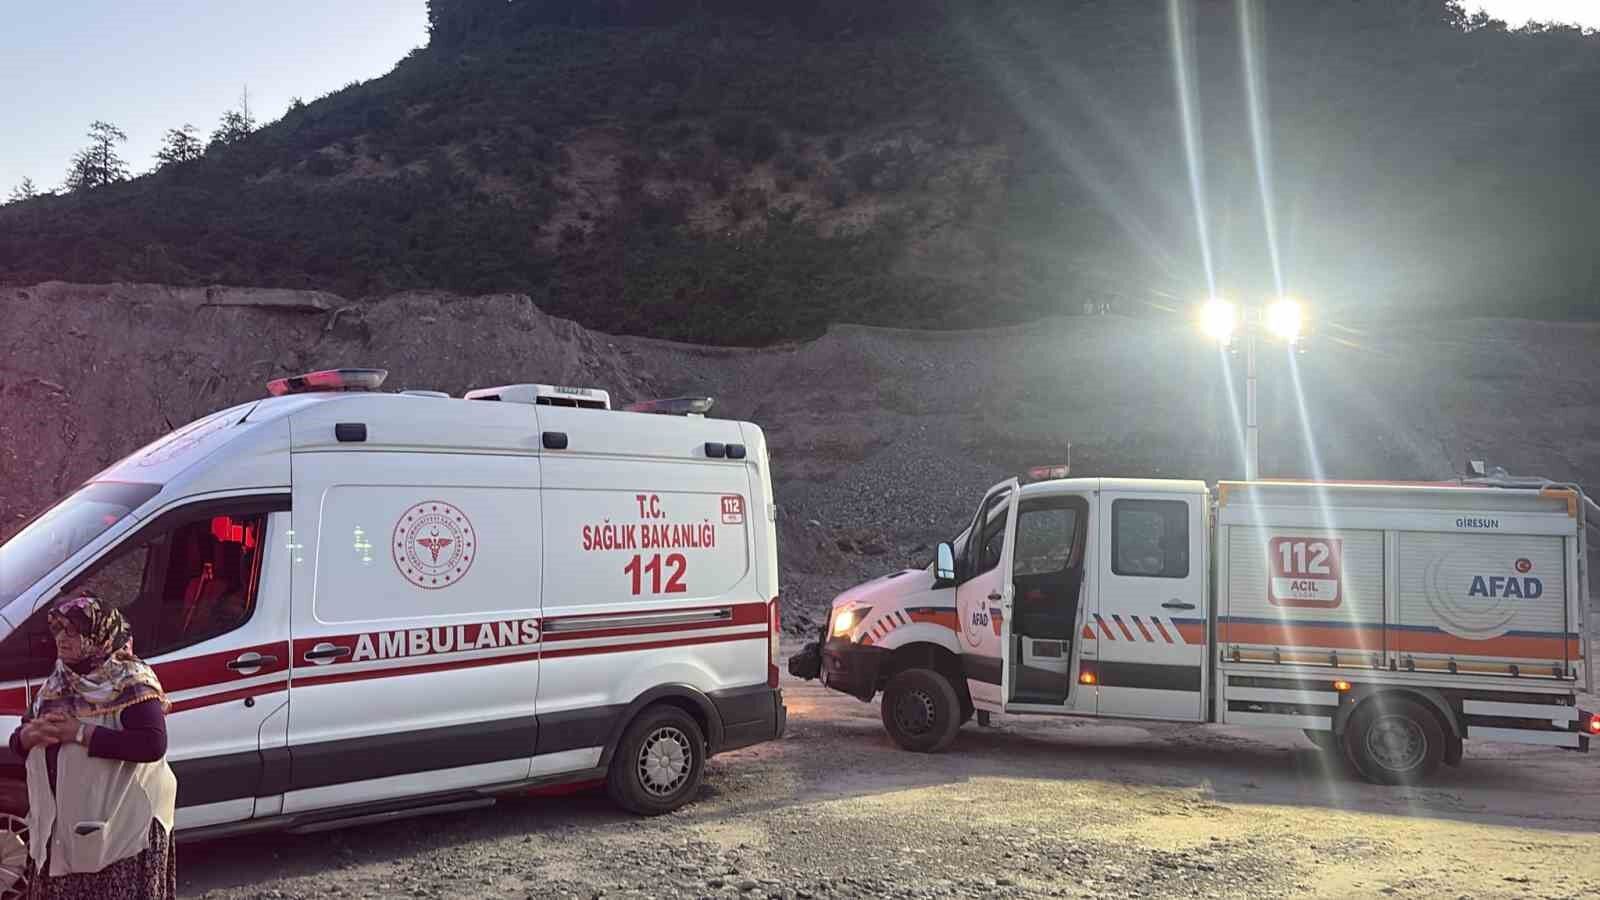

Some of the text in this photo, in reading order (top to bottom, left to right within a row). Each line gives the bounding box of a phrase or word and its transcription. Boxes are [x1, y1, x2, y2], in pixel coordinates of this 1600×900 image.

[636, 495, 665, 518] T.C.
[724, 499, 740, 513] 112
[583, 519, 715, 550] SAĞLIK BAKANLIĞI
[1279, 541, 1331, 575] 112
[624, 553, 687, 595] 112
[1468, 575, 1543, 600] AFAD
[972, 612, 988, 626] AFAD
[351, 619, 540, 662] AMBULANS
